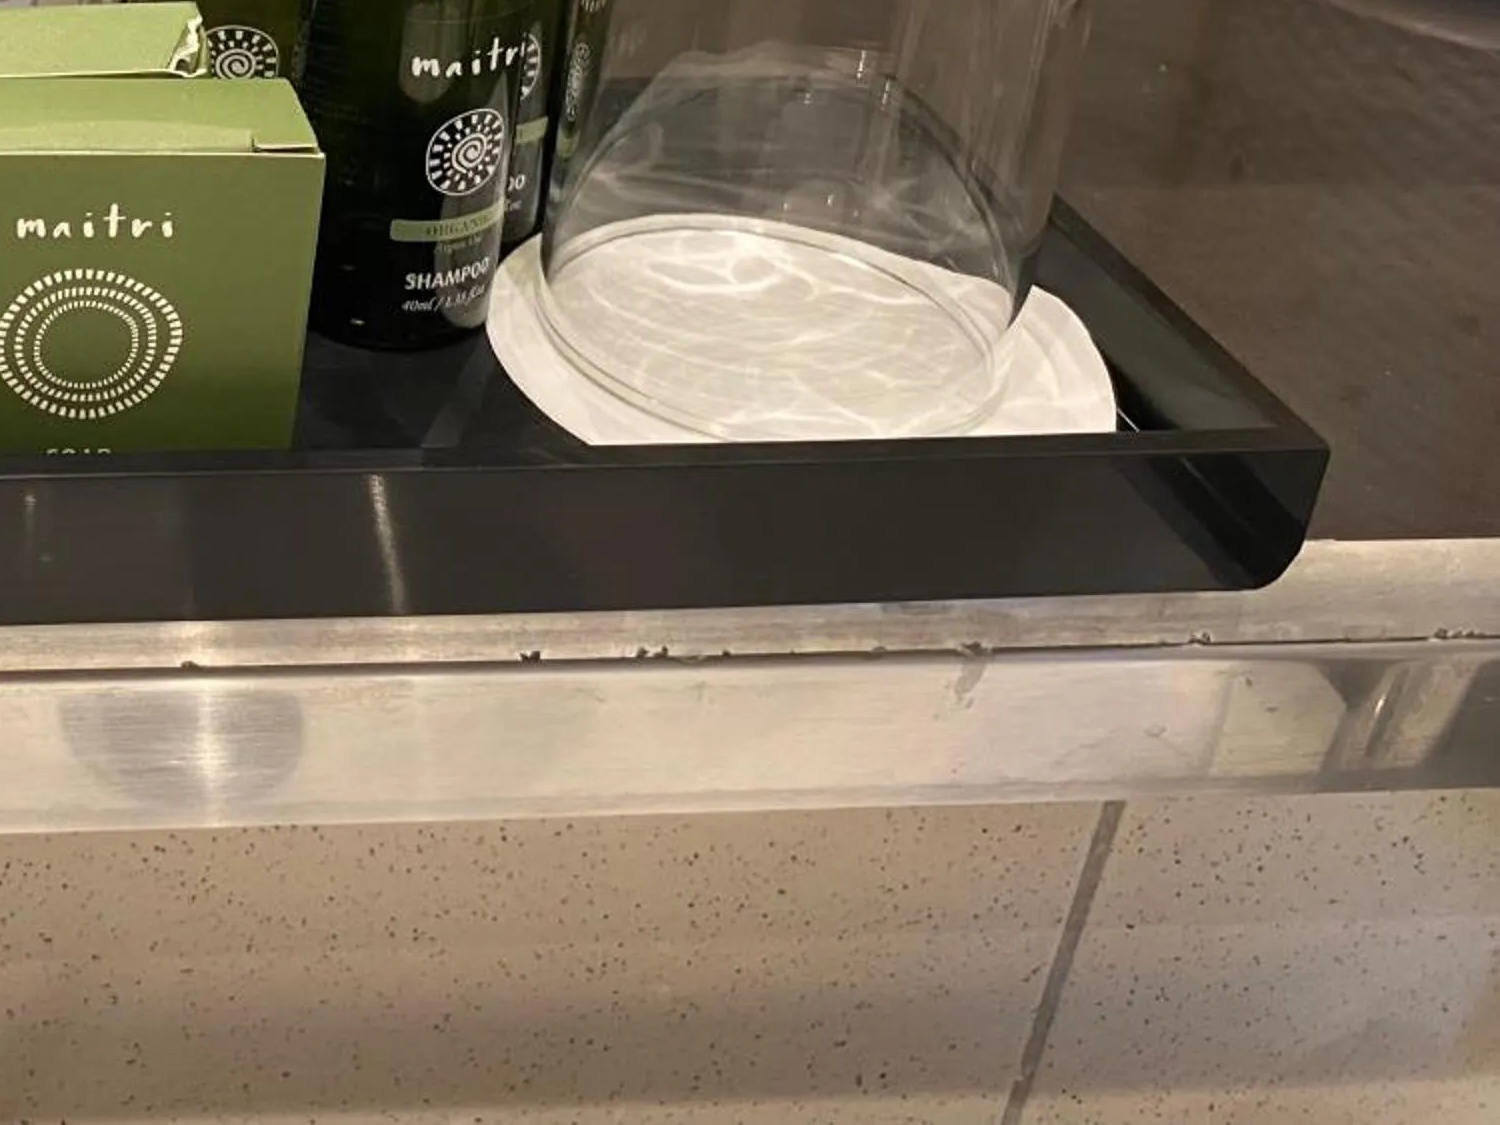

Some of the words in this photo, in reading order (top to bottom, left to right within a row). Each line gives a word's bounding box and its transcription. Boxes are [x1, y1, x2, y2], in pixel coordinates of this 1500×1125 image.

[411, 36, 526, 78] maitri
[17, 203, 173, 238] maitri
[404, 256, 490, 291] SHAMPOO
